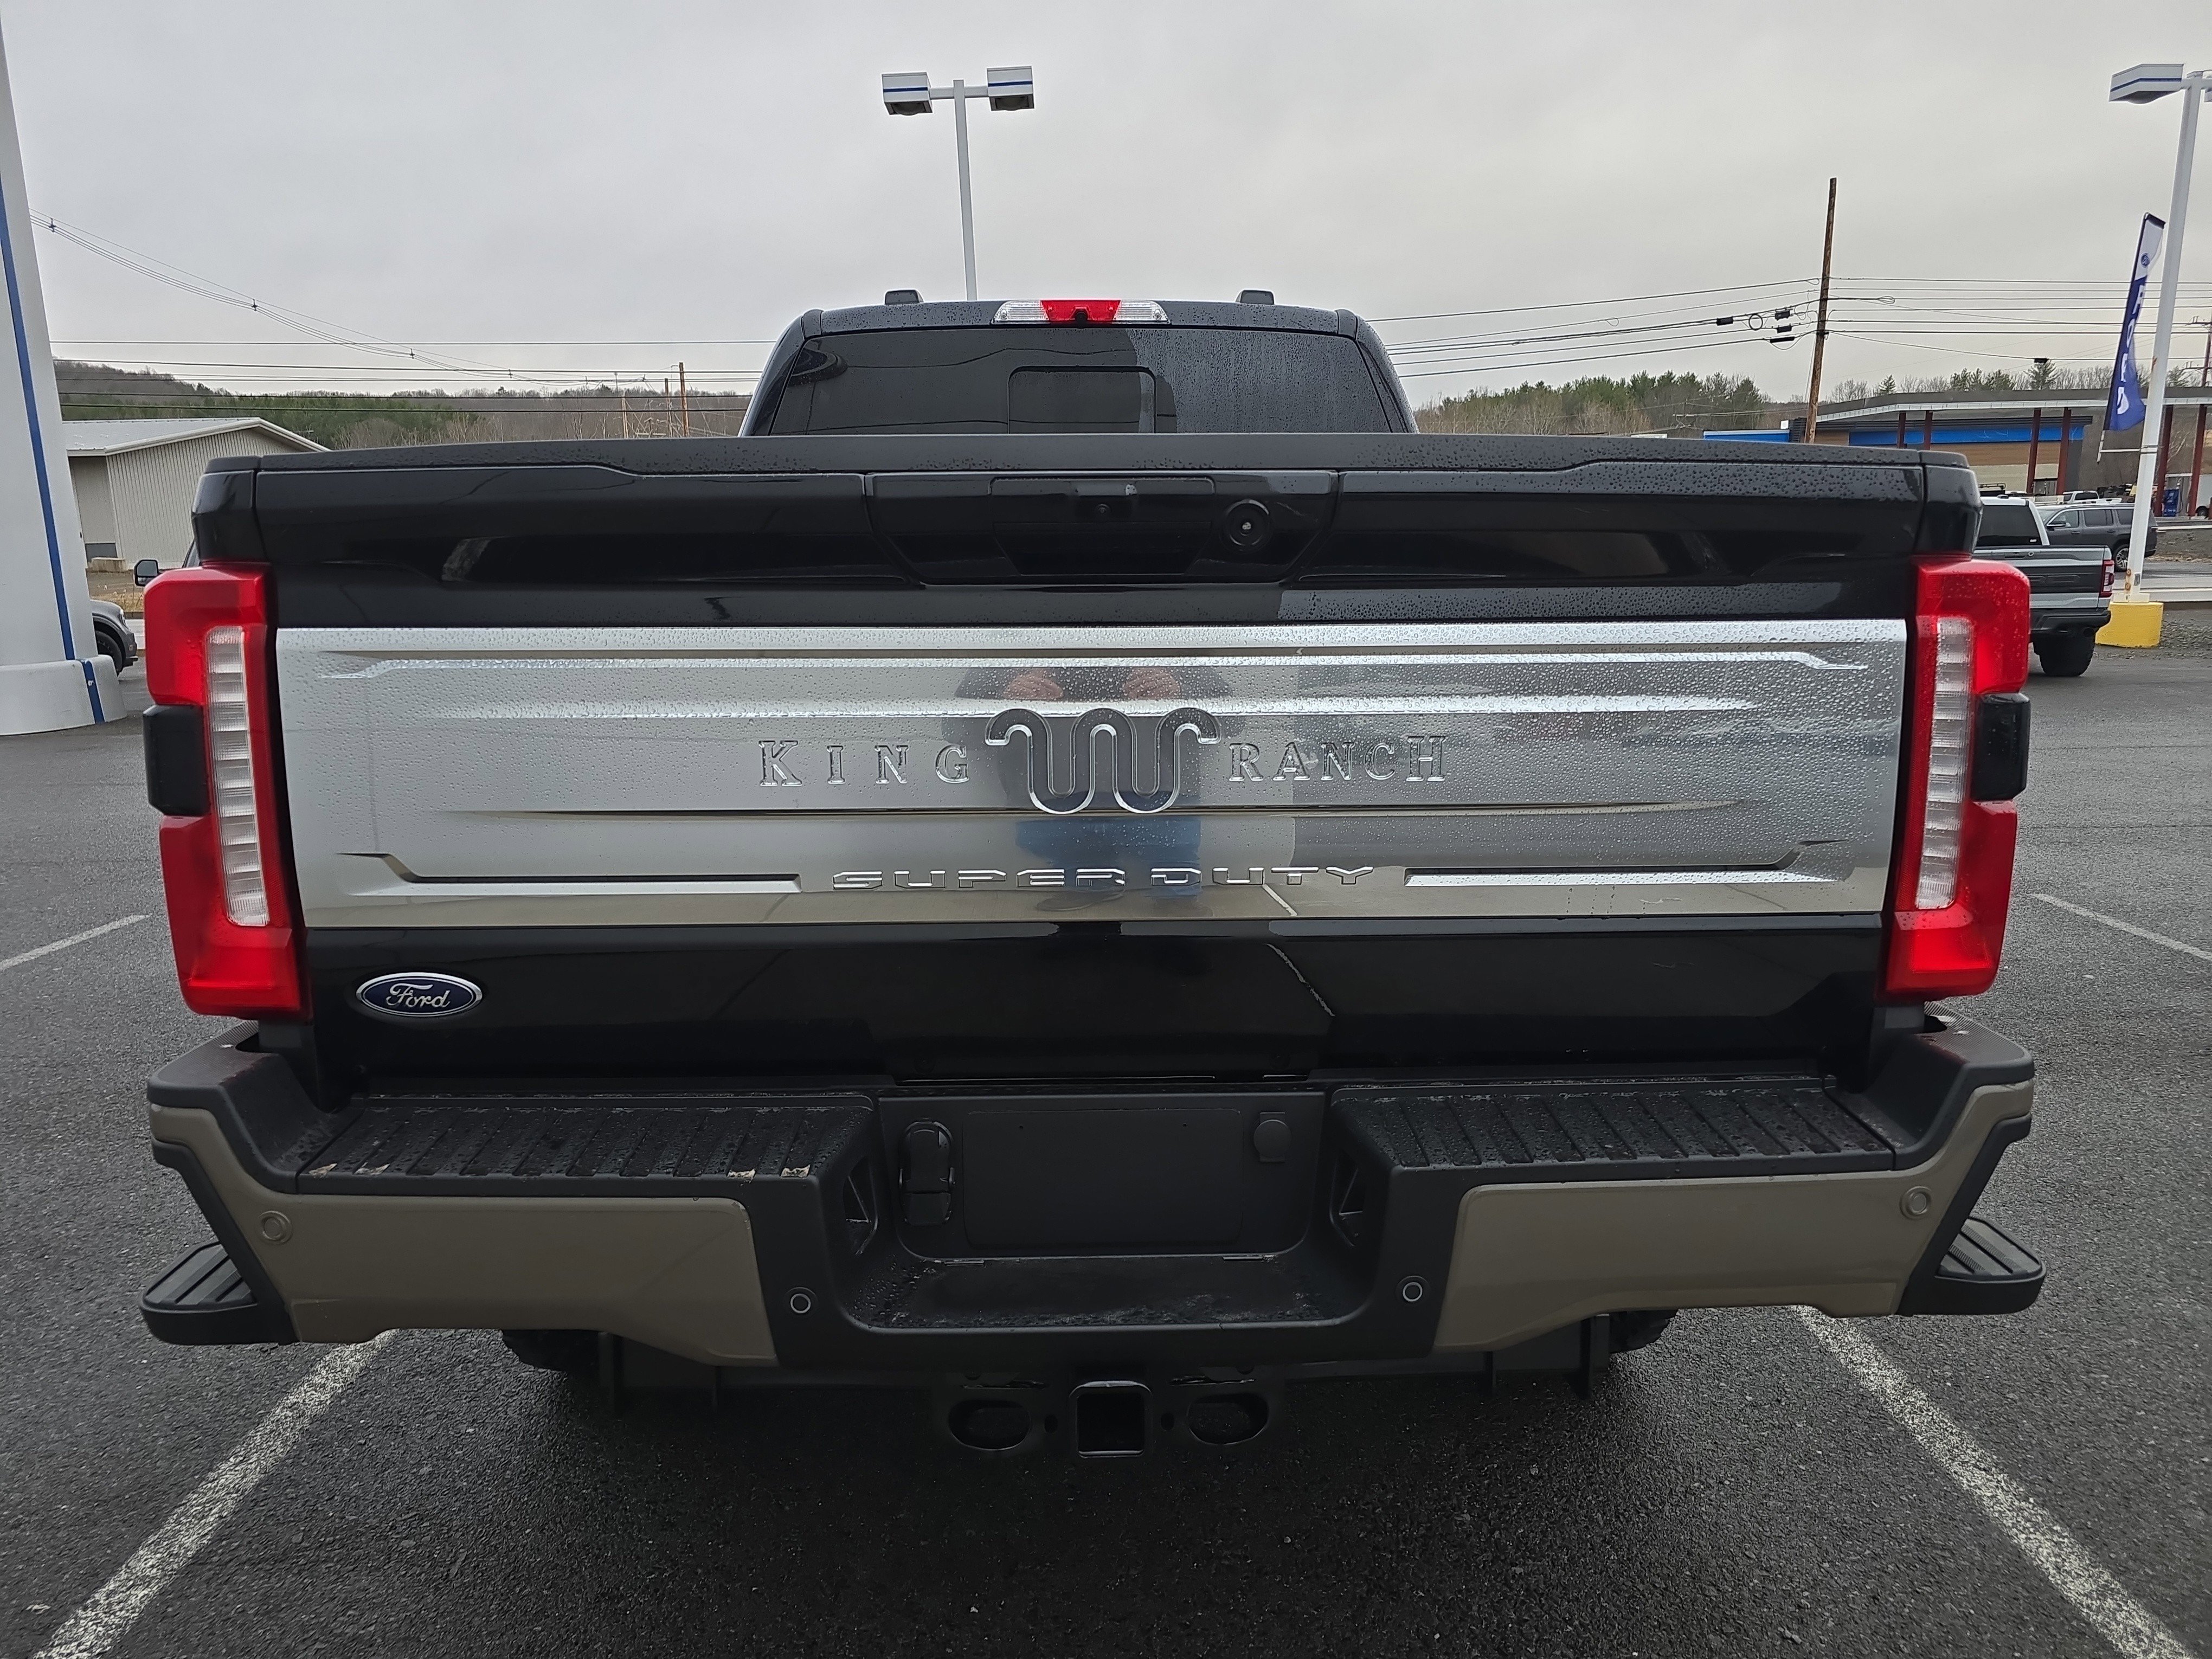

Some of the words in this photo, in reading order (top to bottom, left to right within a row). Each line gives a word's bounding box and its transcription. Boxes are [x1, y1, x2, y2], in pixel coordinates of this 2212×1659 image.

[758, 740, 970, 787] KING
[1229, 735, 1446, 782] RANCH
[832, 869, 1126, 890] SUPER
[1150, 866, 1374, 886] DUTY
[385, 982, 451, 1008] Ford
